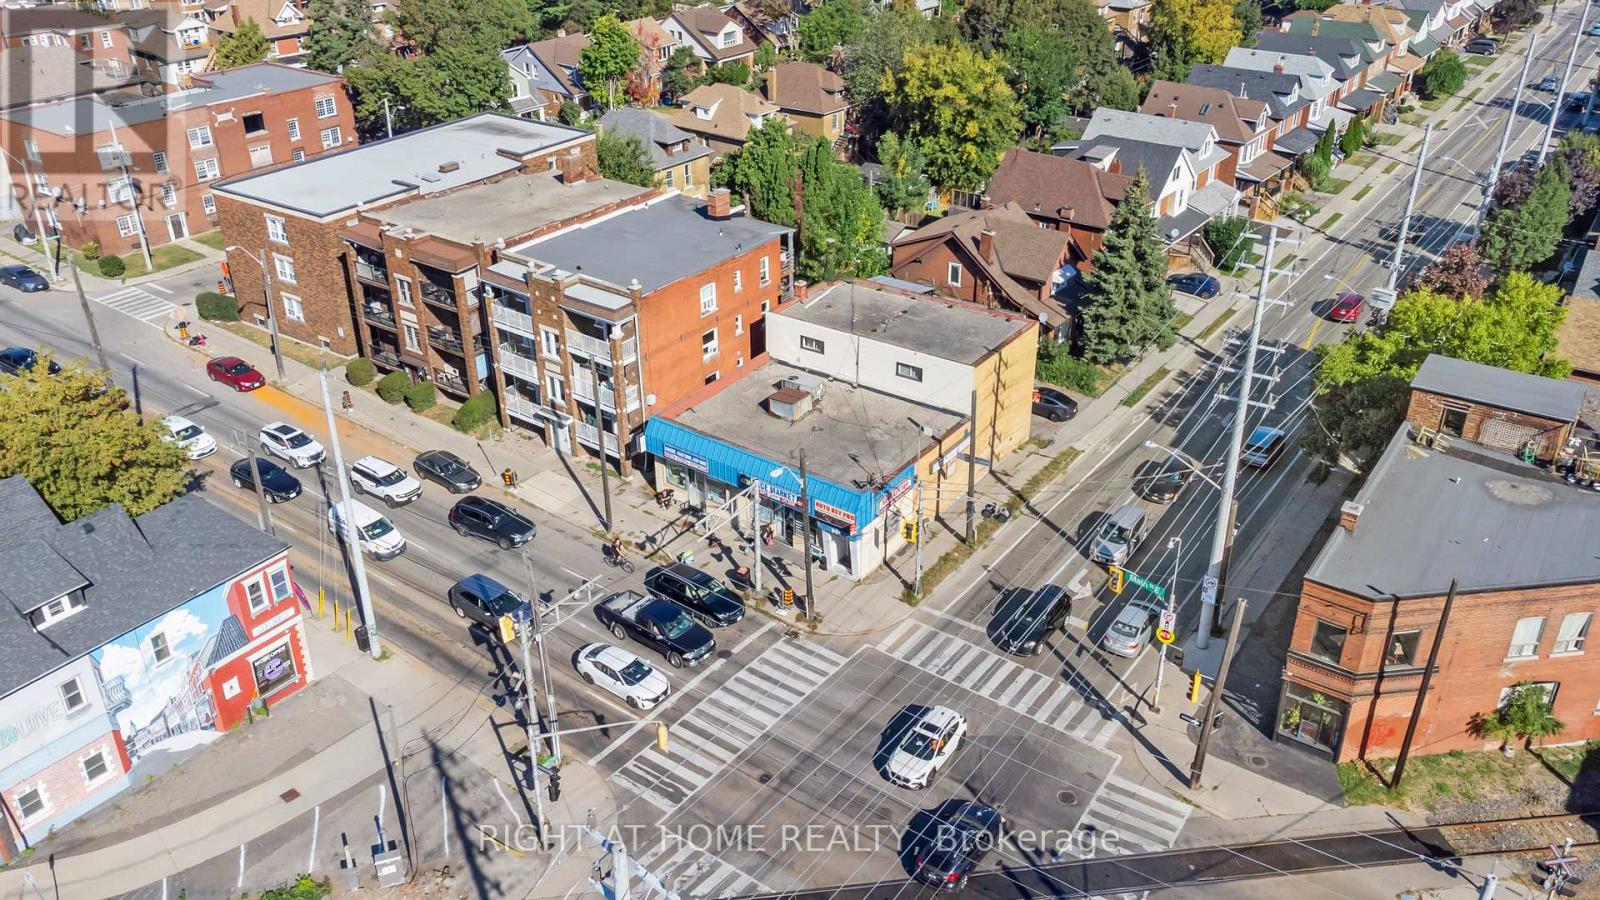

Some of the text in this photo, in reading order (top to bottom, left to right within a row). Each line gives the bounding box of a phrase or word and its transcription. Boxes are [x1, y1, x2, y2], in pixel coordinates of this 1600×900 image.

[770, 484, 797, 501] MARKET
[815, 501, 831, 512] AUTO
[1129, 573, 1148, 588] Main
[1154, 585, 1161, 595] E
